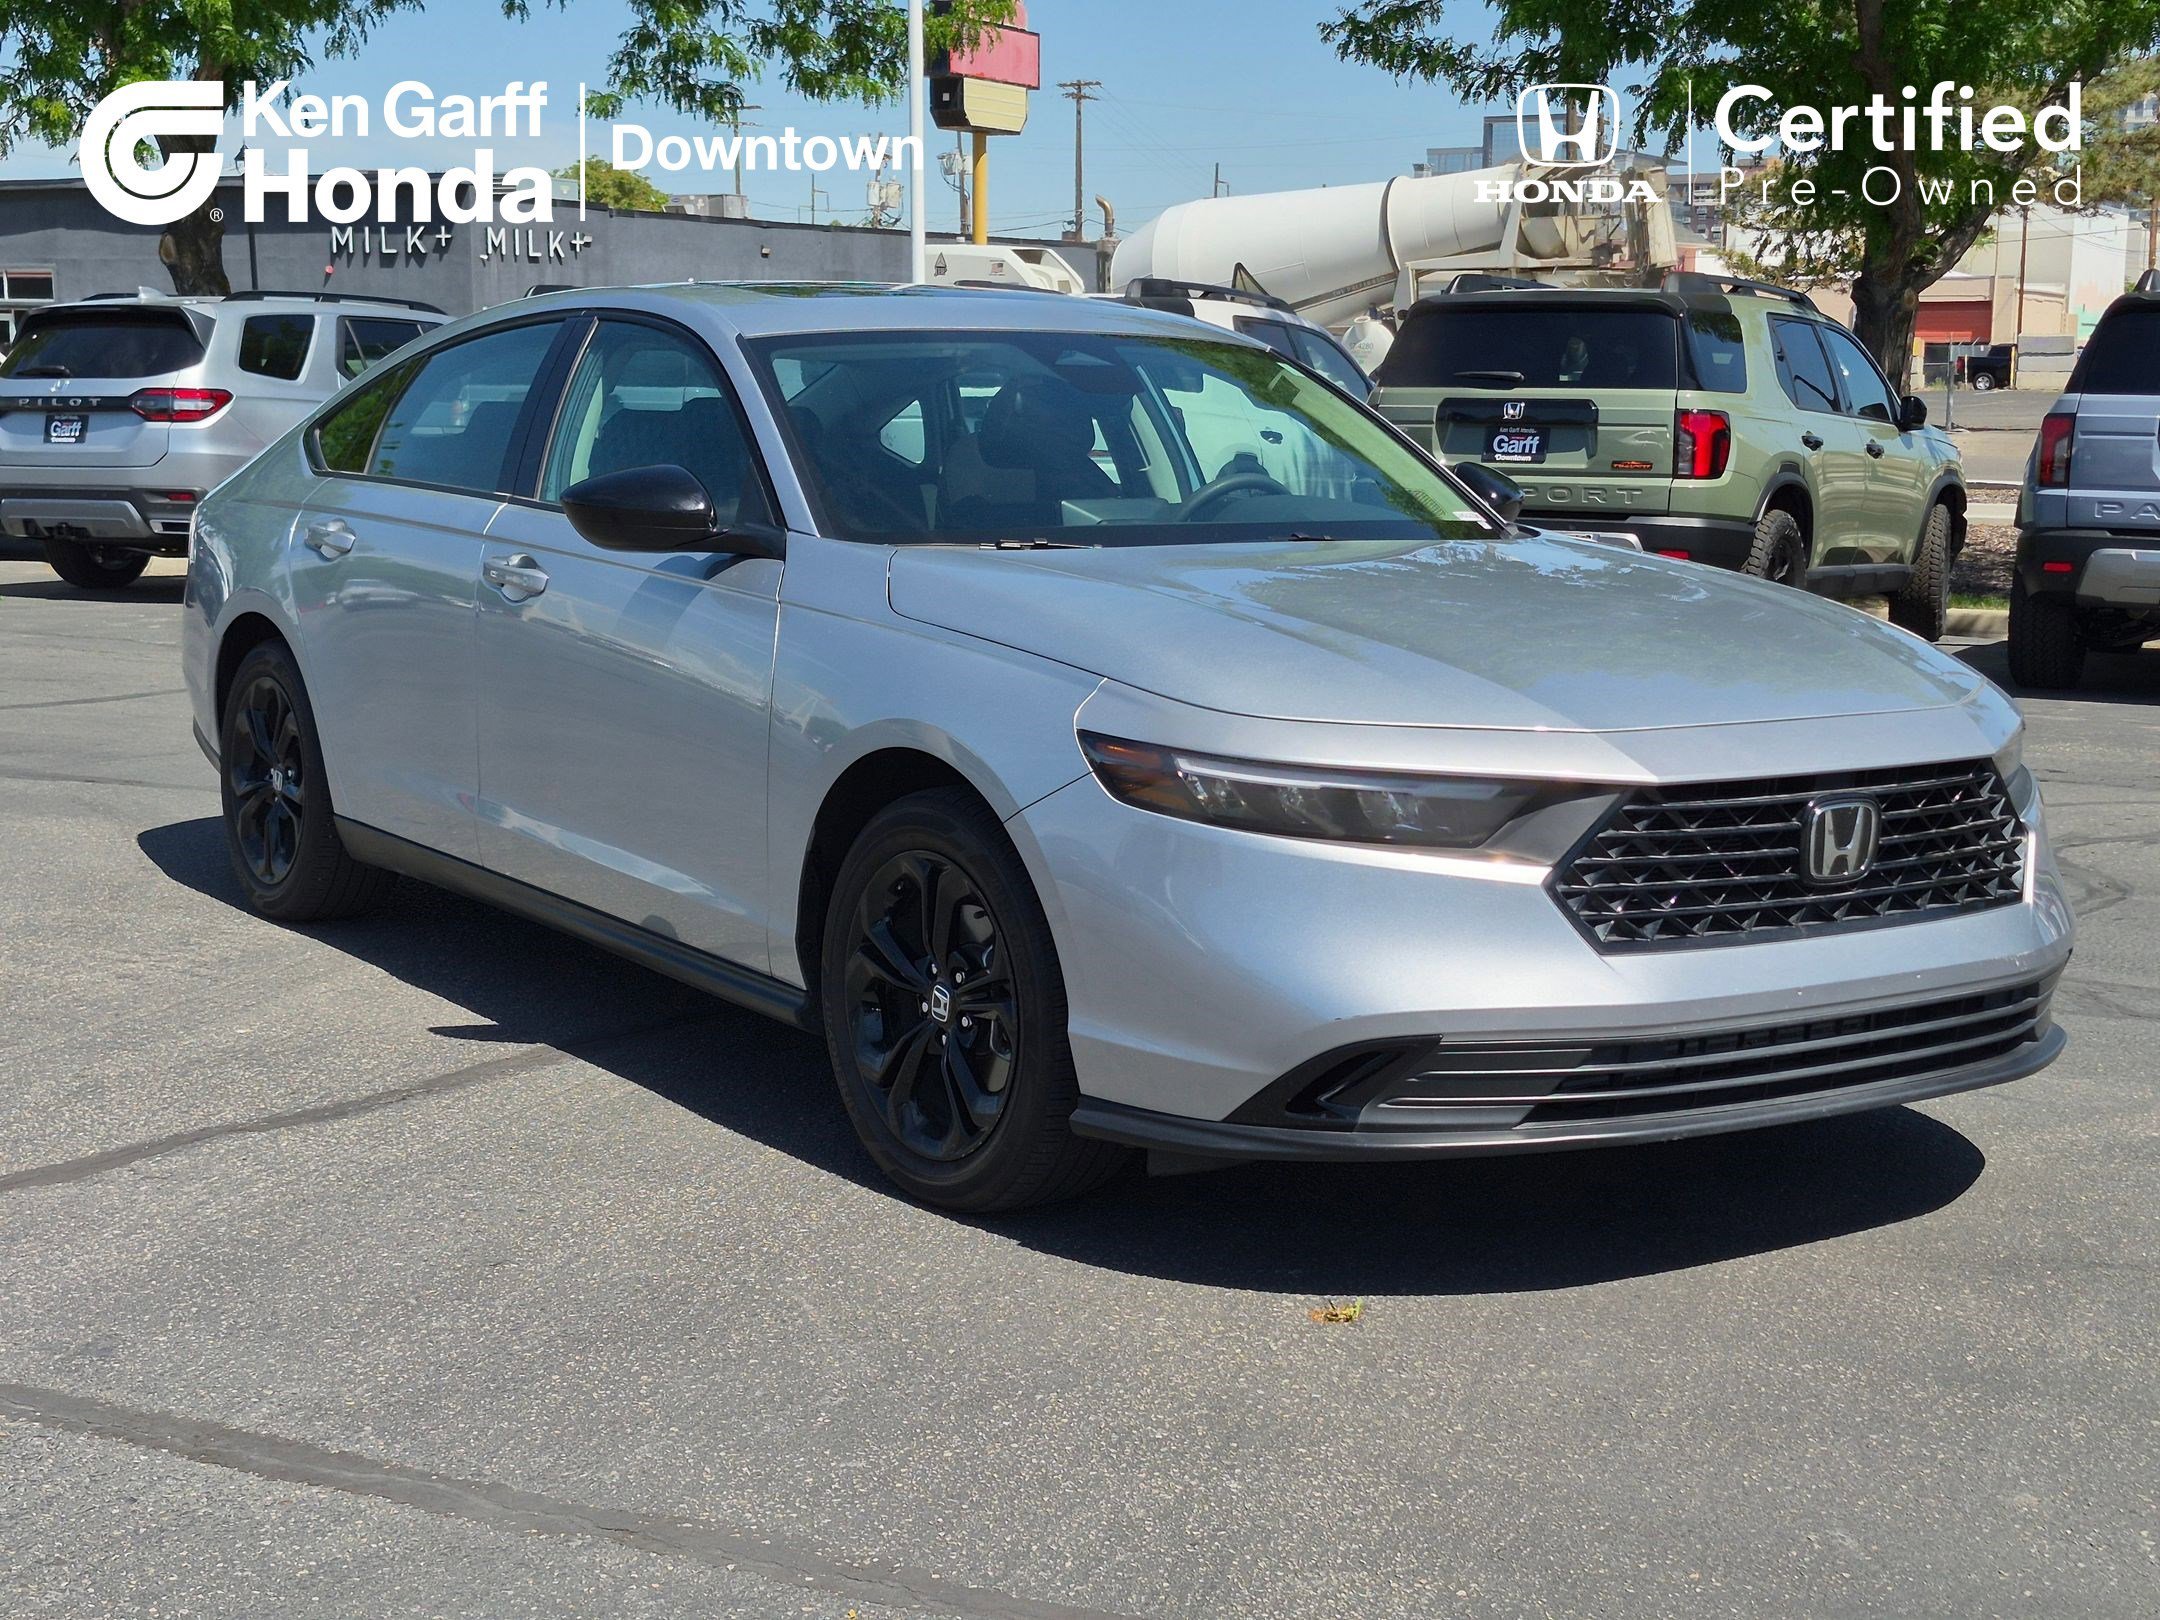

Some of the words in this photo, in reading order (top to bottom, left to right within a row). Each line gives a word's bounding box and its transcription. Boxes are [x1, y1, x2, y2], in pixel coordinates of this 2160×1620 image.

[331, 226, 452, 254] MILK+
[18, 398, 102, 407] PILOT
[50, 420, 83, 437] Garff
[1492, 434, 1540, 454] Garff
